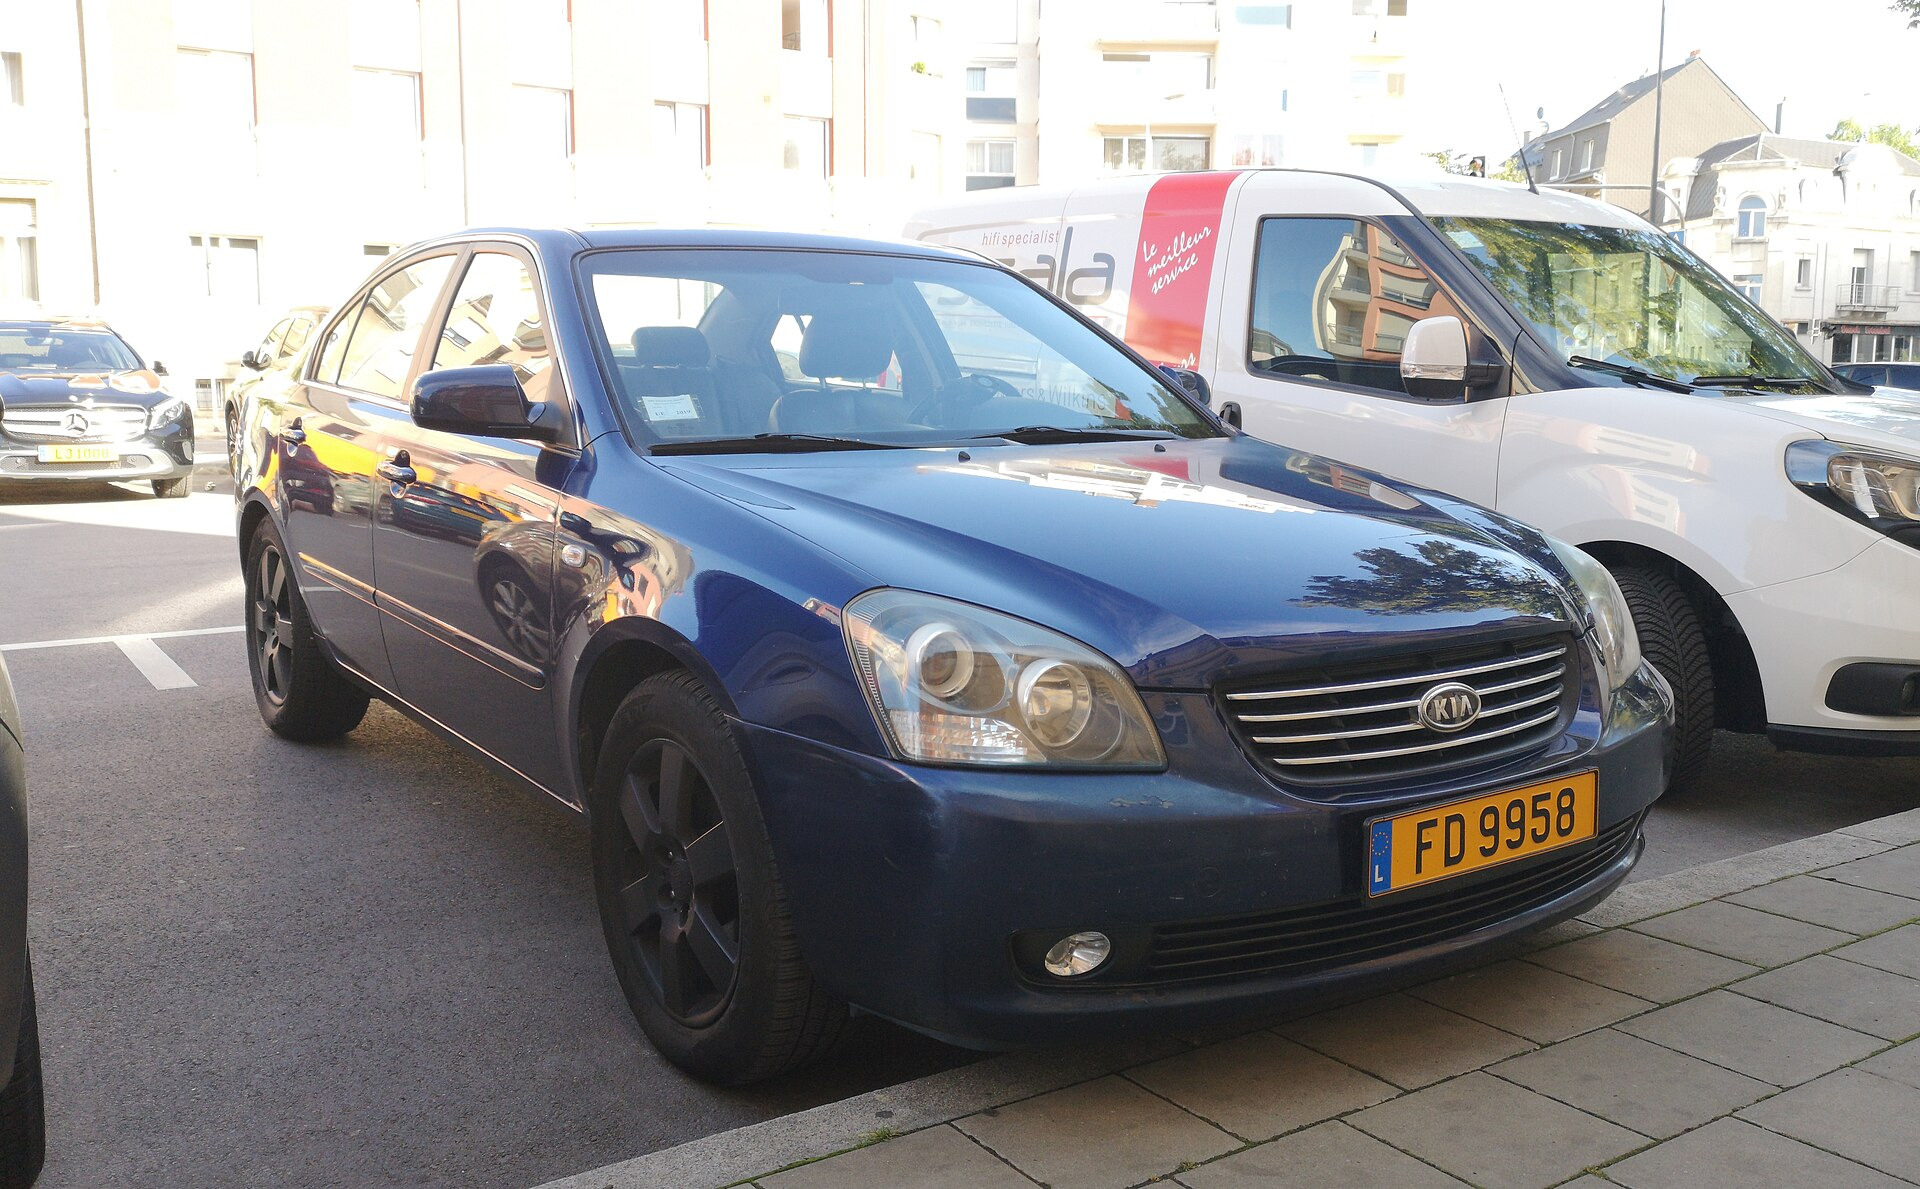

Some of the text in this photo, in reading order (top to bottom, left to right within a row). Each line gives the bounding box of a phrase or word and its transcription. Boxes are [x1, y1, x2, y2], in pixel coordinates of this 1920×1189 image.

[981, 229, 1060, 248] hifi specialist
[1143, 240, 1158, 262] Le
[1147, 226, 1212, 278] meilleur
[1151, 252, 1199, 295] service
[1432, 694, 1474, 721] KIA
[1374, 787, 1576, 883] L FD 9958
